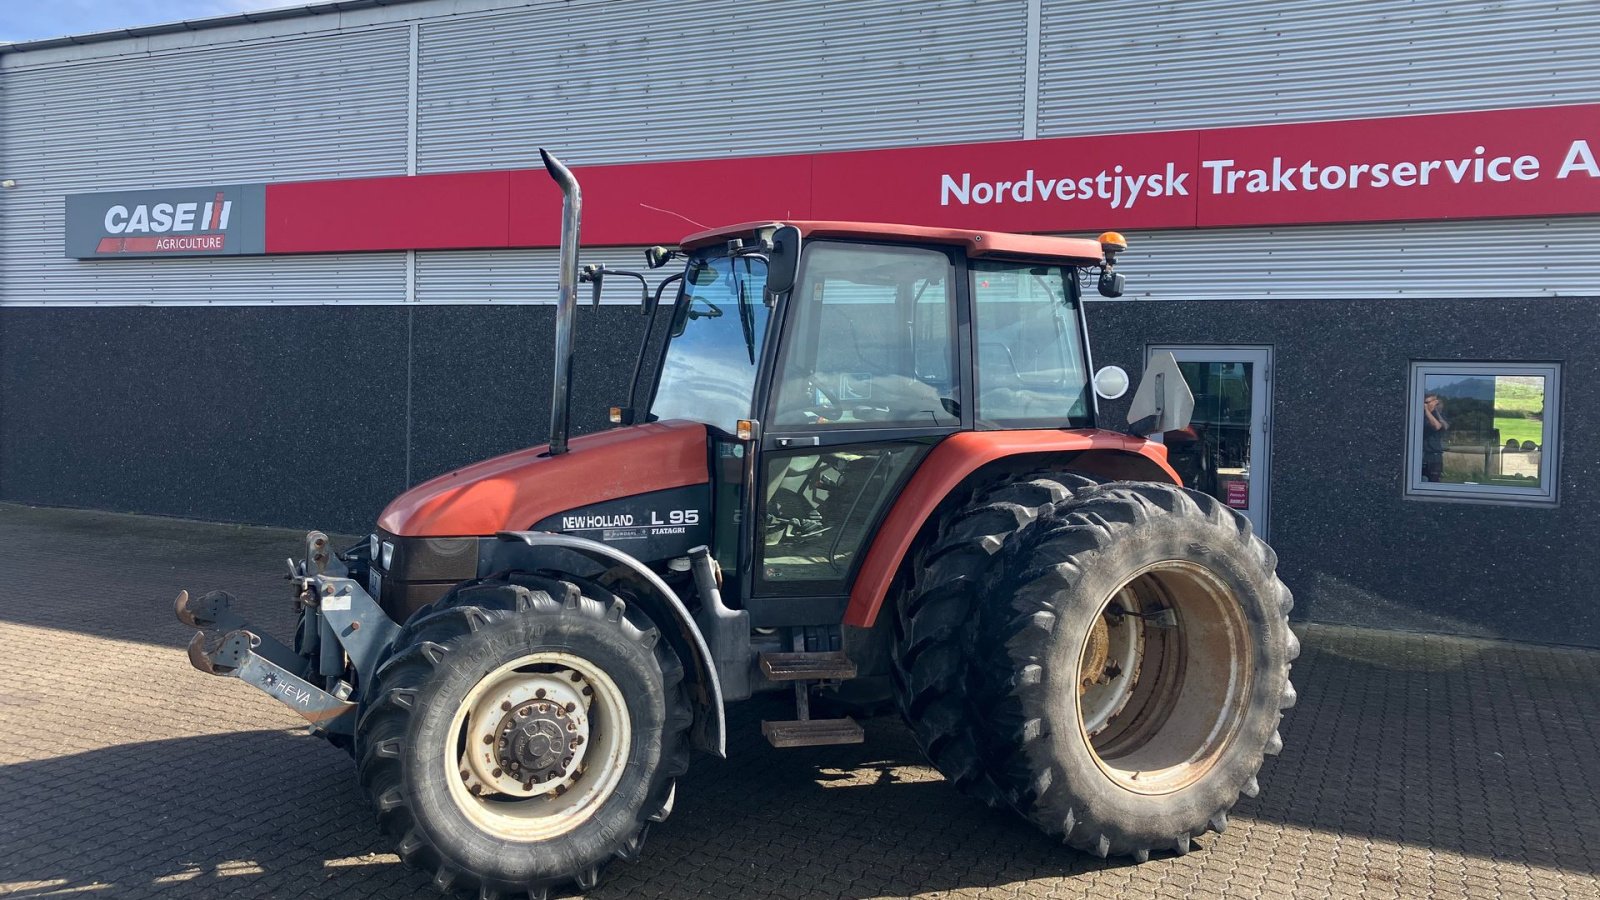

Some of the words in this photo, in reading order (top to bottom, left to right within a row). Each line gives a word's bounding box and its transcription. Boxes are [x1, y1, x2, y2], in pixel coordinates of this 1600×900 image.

[940, 162, 1190, 209] Nordvestjysk
[1202, 145, 1540, 194] Traktorservice
[1556, 140, 1600, 179] A
[104, 202, 198, 234] CASE
[156, 237, 222, 250] AGRICULTURE
[563, 516, 587, 529] NEW
[587, 514, 634, 527] HOLLAND
[651, 511, 664, 525] L
[669, 509, 699, 524] 95
[651, 527, 686, 535] FIATAGRI
[275, 679, 311, 707] HE-VA
